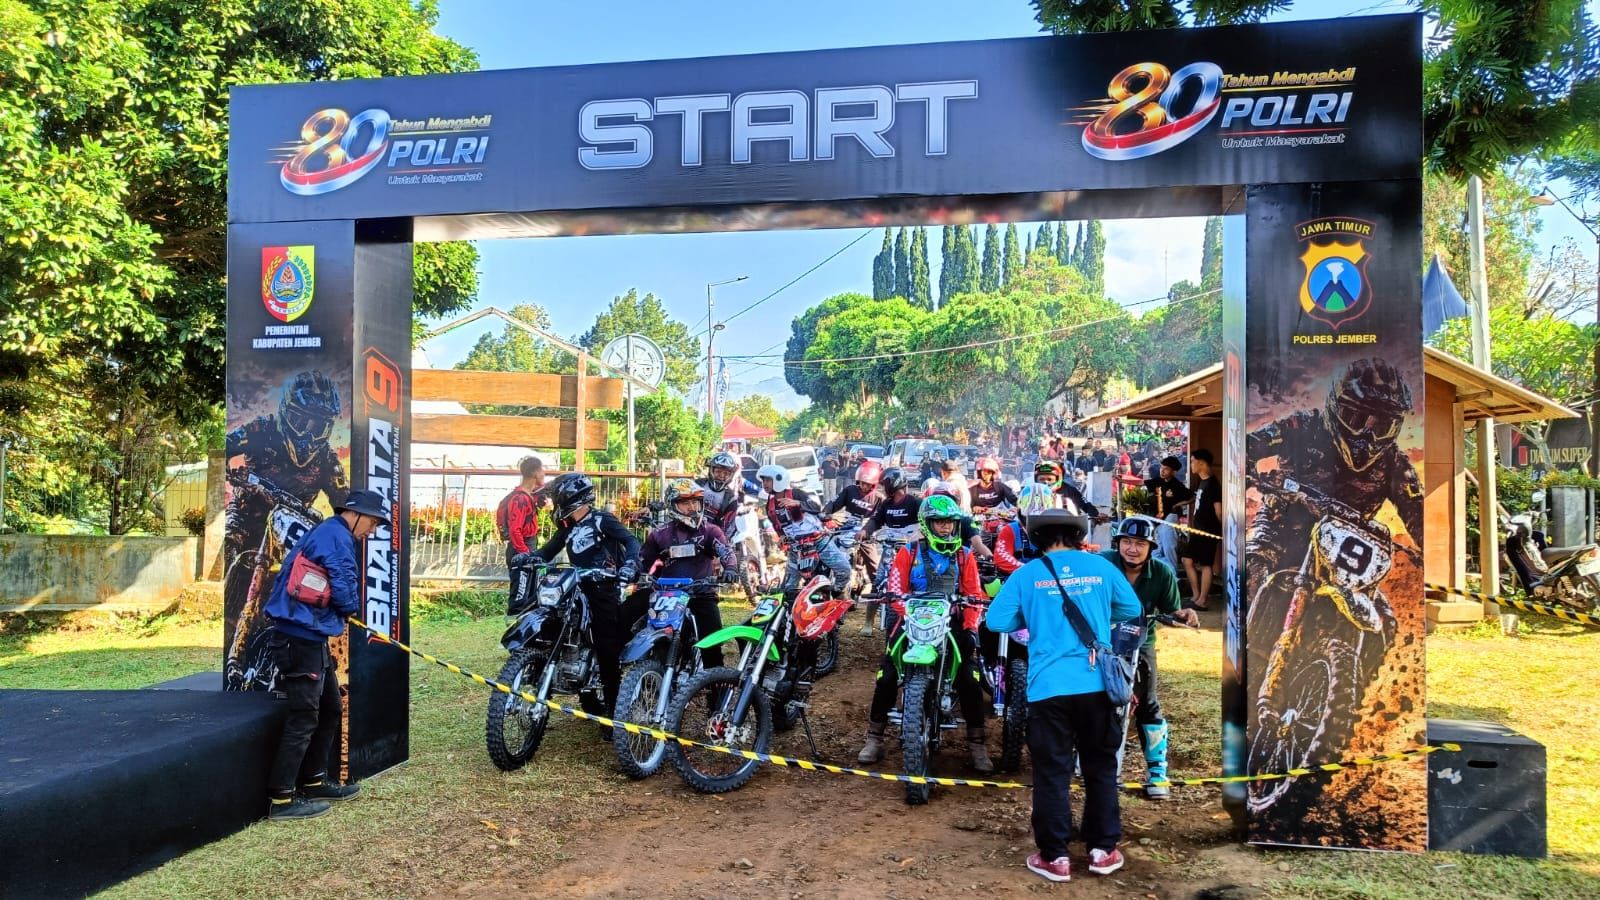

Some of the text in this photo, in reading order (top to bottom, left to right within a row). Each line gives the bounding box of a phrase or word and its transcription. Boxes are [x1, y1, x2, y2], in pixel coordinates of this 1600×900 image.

[1221, 66, 1356, 88] Tahun Mengabdi
[388, 114, 492, 131] Tahun Mengabdi
[1081, 61, 1224, 161] 80
[1221, 92, 1353, 128] POLRI
[577, 79, 979, 171] START
[280, 108, 390, 196] 80
[388, 136, 489, 167] POLRI
[1221, 133, 1346, 149] Untuk Masyarakat
[388, 172, 483, 186] Untuk Masyarakat
[1301, 221, 1371, 237] JAWA TIMUR
[252, 337, 321, 348] KABUPATEN JEMBER
[264, 325, 309, 336] PEMERINTAH
[1293, 334, 1377, 344] POLRES JEMBER
[366, 355, 398, 412] 9
[391, 425, 401, 617] BHAYANGKARA ARGOPURO ADVENTURE TRAIL
[1335, 535, 1374, 577] 9
